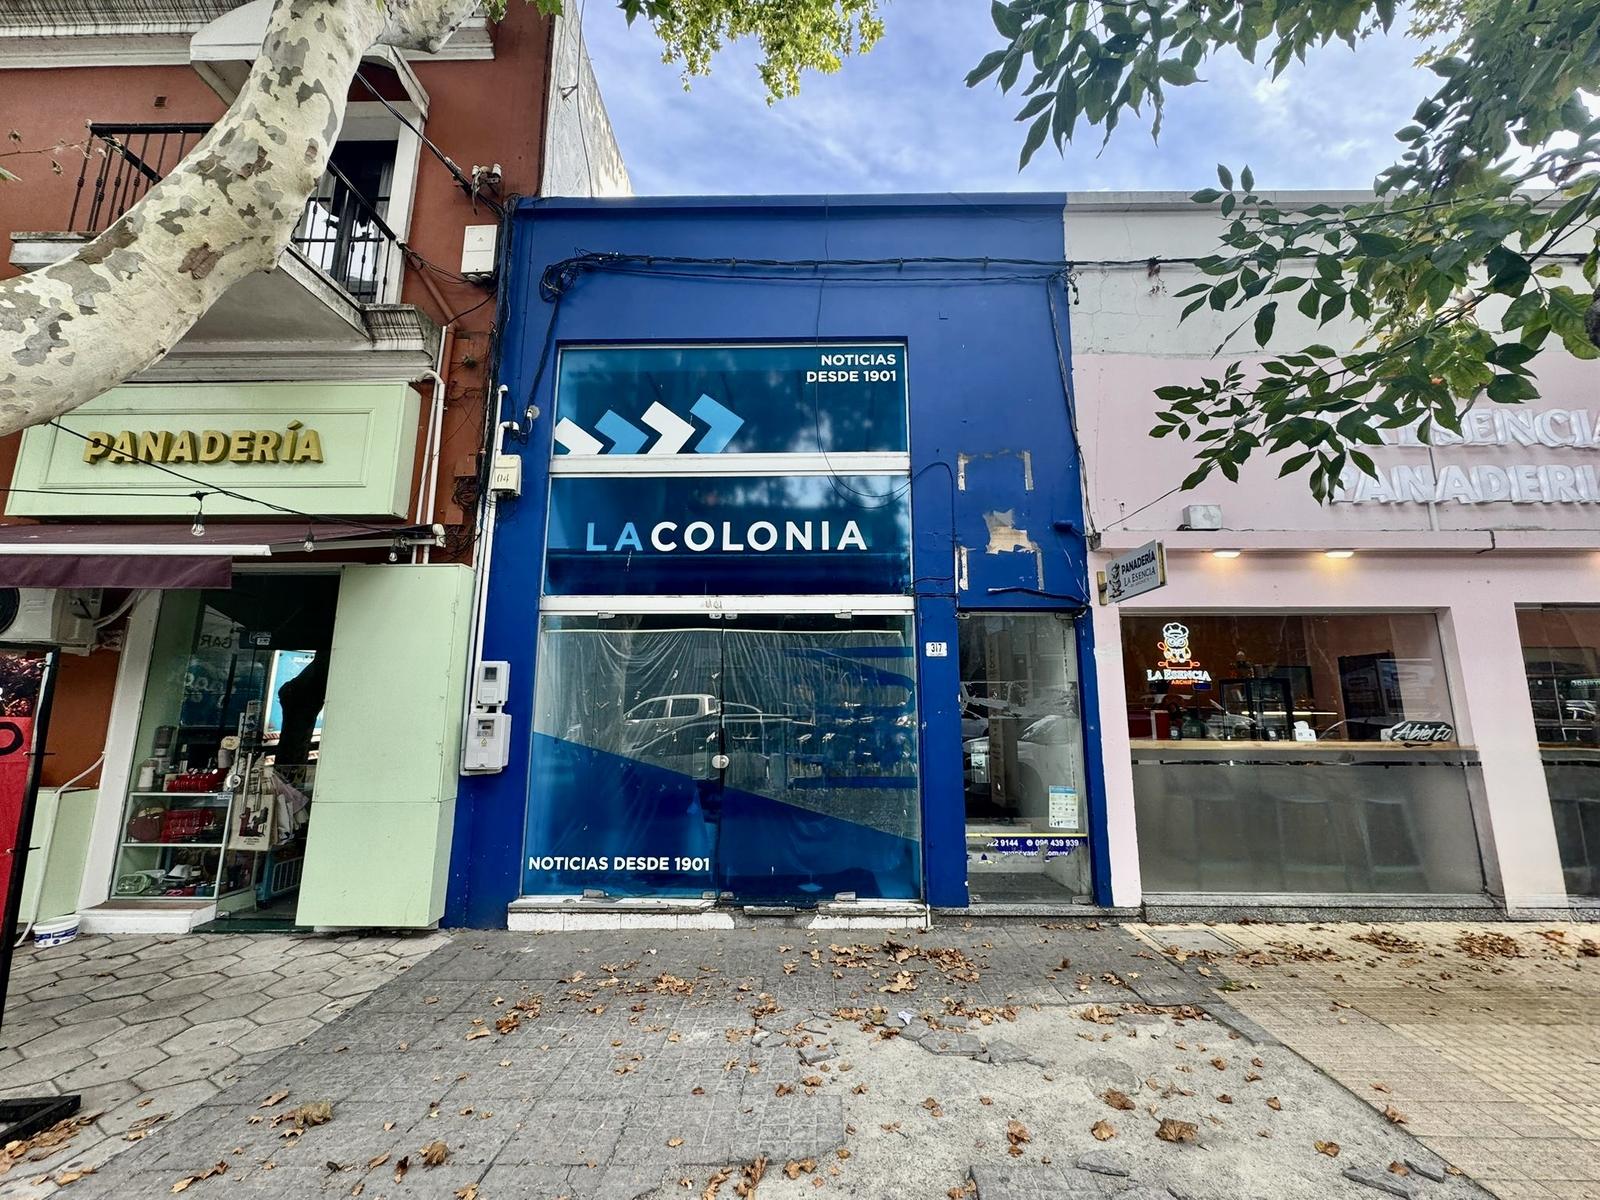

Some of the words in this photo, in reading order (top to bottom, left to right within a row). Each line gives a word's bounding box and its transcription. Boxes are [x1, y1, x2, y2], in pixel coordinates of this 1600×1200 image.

[821, 354, 896, 366] NOTICIAS
[806, 371, 859, 383] DESDE
[863, 370, 896, 382] 1901
[1398, 408, 1600, 448] ENCI
[83, 420, 324, 464] PANADERÍA
[1121, 548, 1156, 575] PANADERÍA
[930, 643, 943, 653] 317
[1147, 669, 1163, 681] LA
[1392, 723, 1453, 741] Abierto
[1000, 839, 1019, 847] 9144
[1050, 839, 1064, 847] 439
[1065, 839, 1079, 847] 939
[528, 856, 609, 871] NOTICIAS
[614, 856, 669, 871] DESDE
[674, 857, 710, 871] 1901
